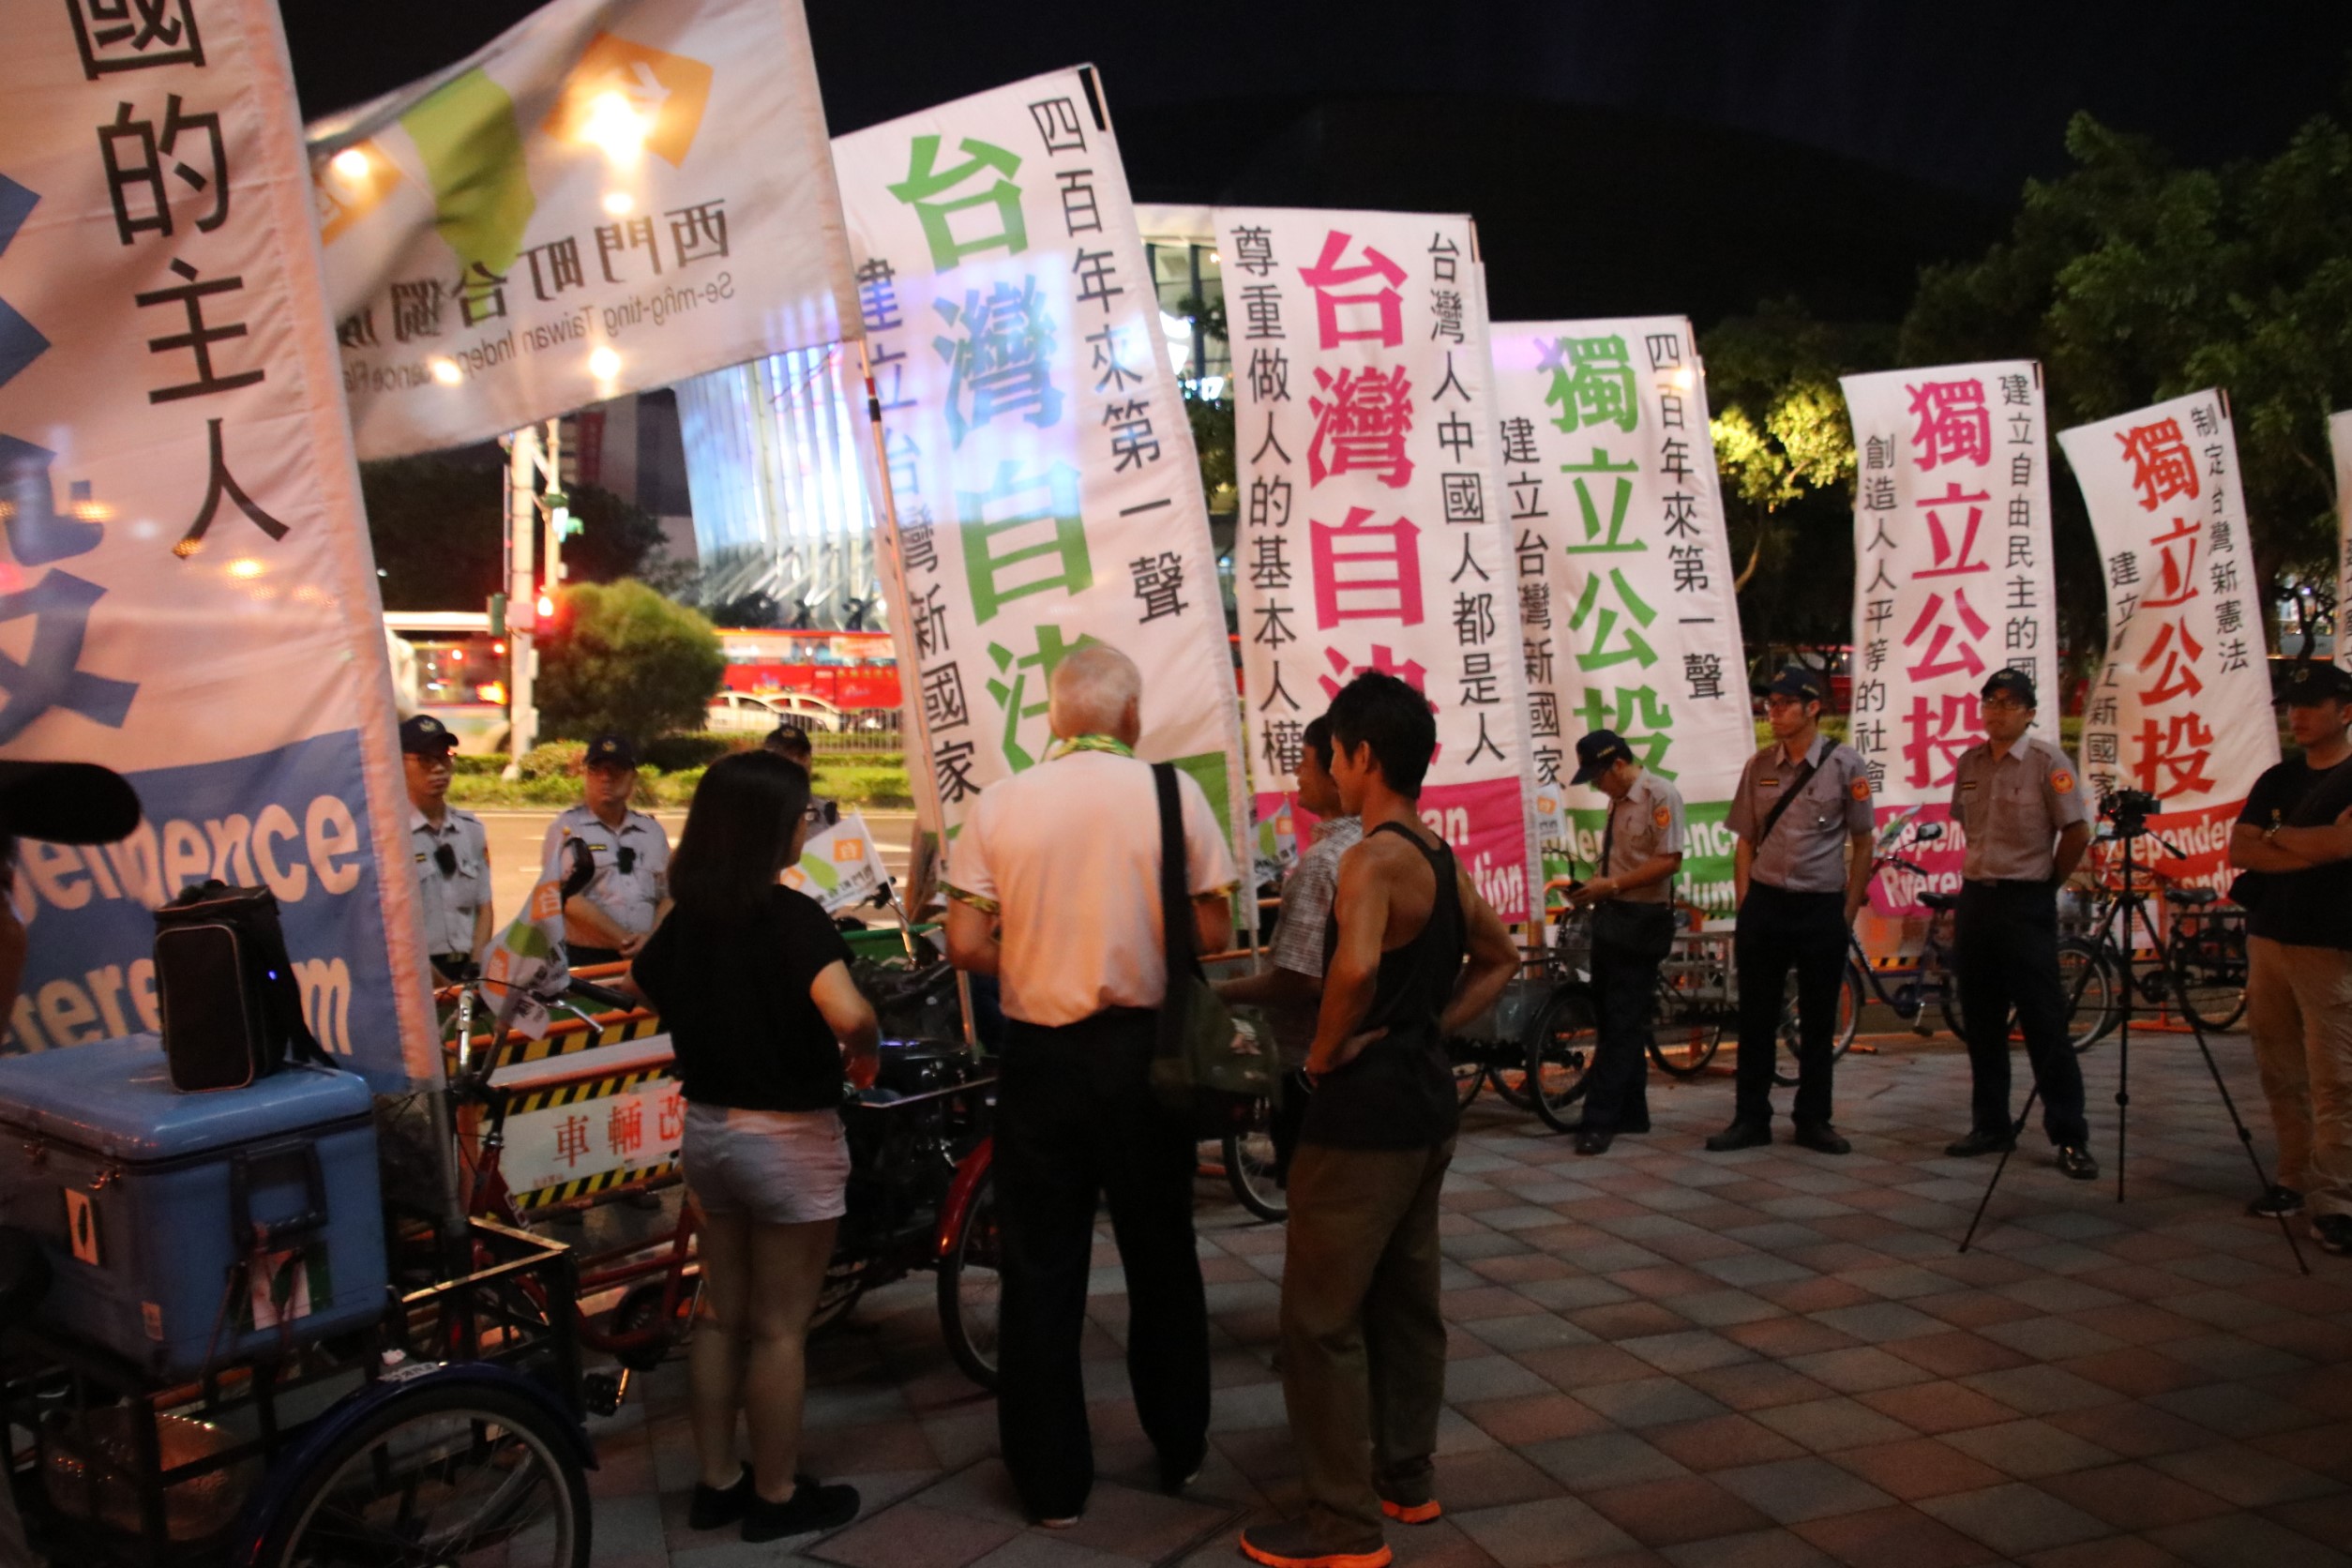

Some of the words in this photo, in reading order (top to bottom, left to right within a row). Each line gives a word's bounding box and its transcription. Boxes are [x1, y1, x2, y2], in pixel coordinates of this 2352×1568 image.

[1027, 97, 1189, 625] 四百年來第一聲
[1230, 225, 1305, 776] 尊重做人的基本人權
[1427, 232, 1506, 766] 台灣人中國人都是人
[1645, 334, 1725, 701] 四百年來第一聲
[2114, 417, 2216, 800] 獨立公投
